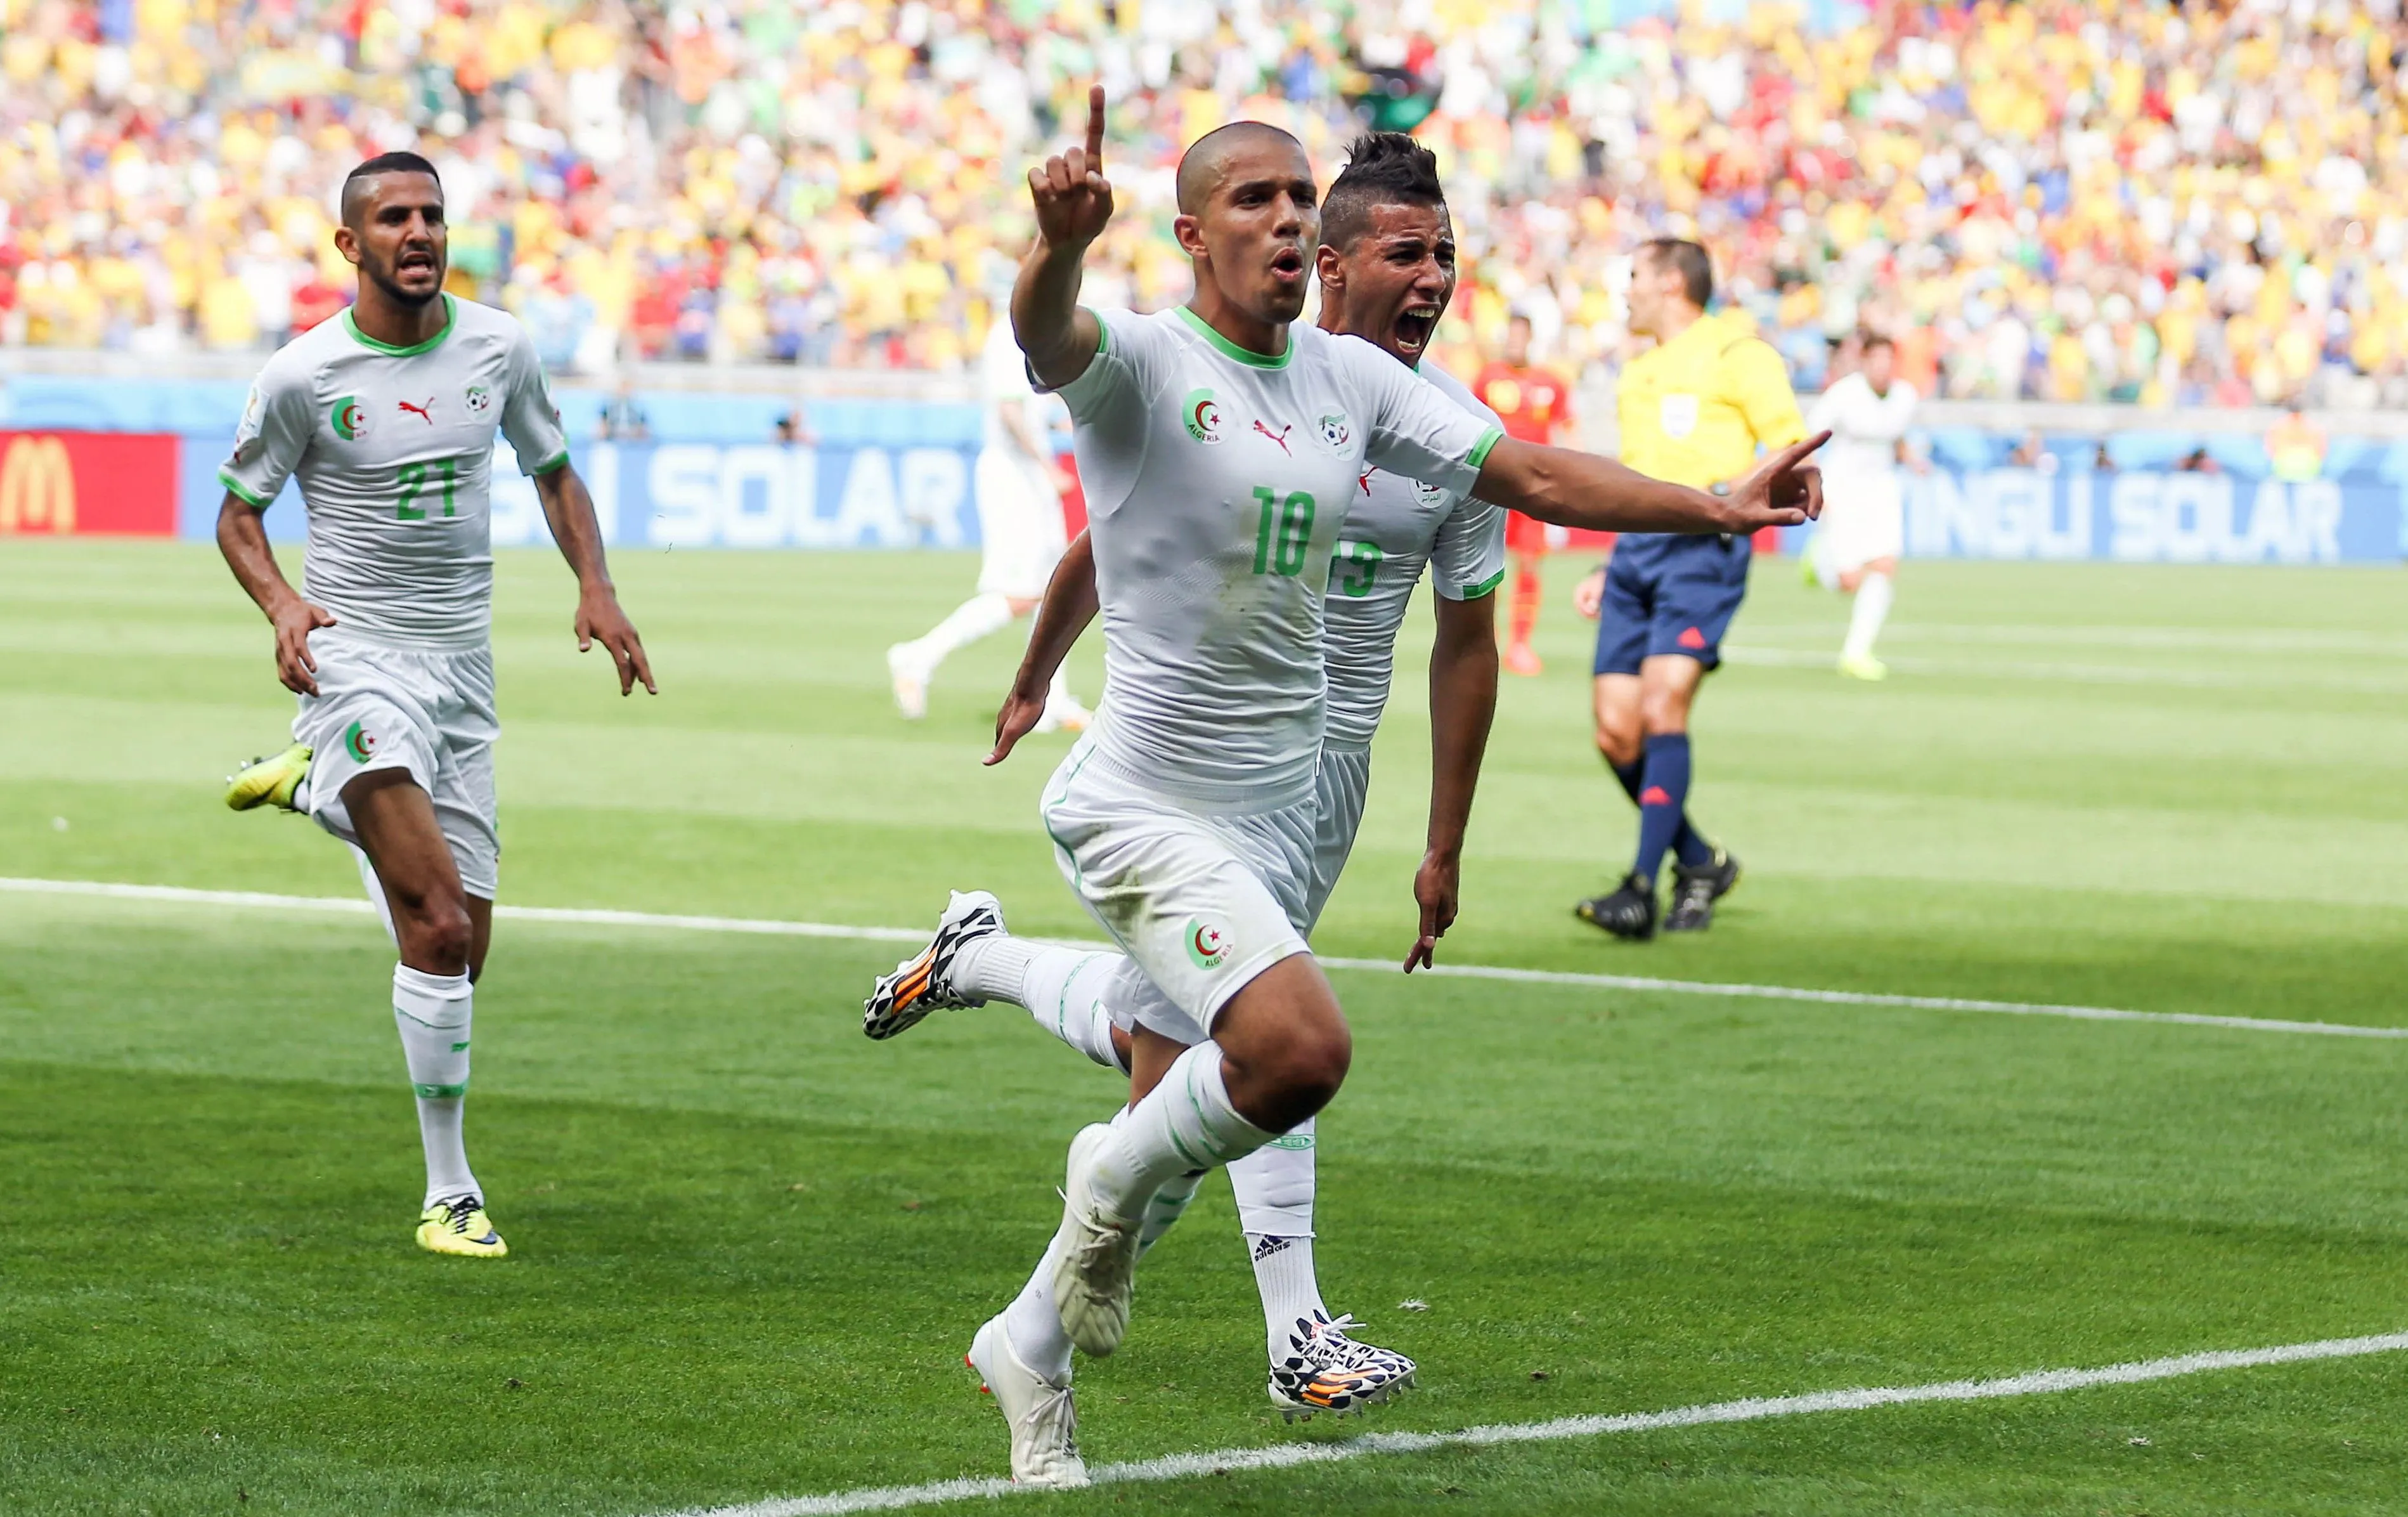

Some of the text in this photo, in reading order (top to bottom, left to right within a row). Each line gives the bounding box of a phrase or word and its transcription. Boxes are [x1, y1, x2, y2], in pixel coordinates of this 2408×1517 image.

[1188, 424, 1221, 442] ALGERIA
[398, 457, 455, 520] 21
[647, 444, 966, 548] SOLAR
[2109, 471, 2341, 562] SOLAR
[1253, 485, 1316, 576] 10
[1255, 1240, 1291, 1261] adidas
